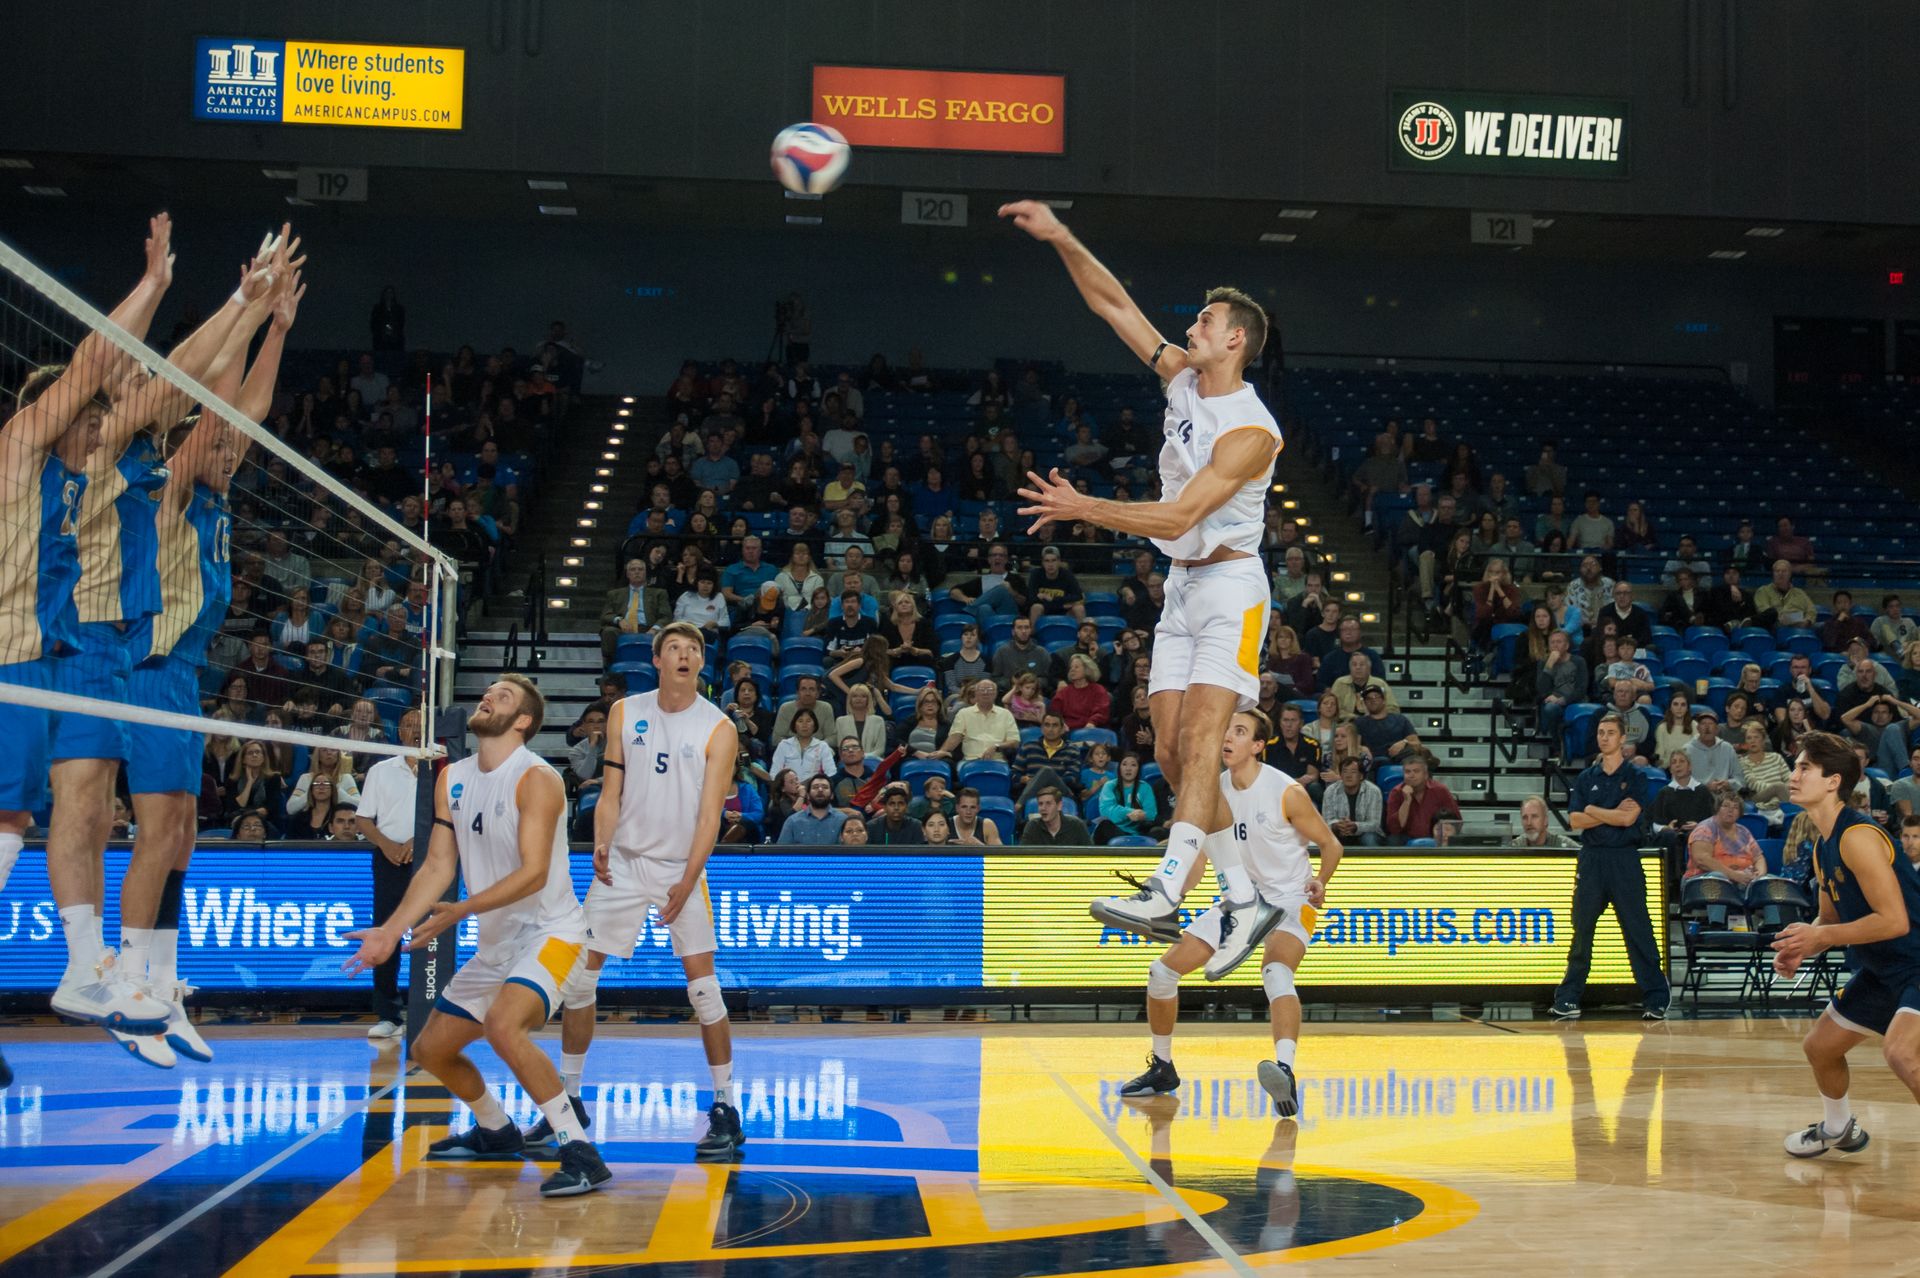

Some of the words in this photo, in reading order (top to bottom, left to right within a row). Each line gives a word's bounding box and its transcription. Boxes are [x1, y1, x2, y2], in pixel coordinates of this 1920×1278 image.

[297, 48, 357, 71] Where
[364, 53, 445, 74] students
[207, 86, 277, 97] AMERICAN
[296, 72, 334, 94] love
[341, 75, 396, 101] living.
[206, 107, 276, 116] COMMUNITIES
[207, 96, 277, 107] CAMPUS
[822, 95, 937, 120] WELLS
[945, 100, 1054, 124] FARGO
[294, 104, 450, 122] AMERICANCAMPUS.COM
[1464, 111, 1505, 156] WE
[1507, 113, 1622, 161] DELIVER!
[318, 173, 348, 195] 119
[915, 198, 953, 220] 120
[1487, 218, 1516, 240] 121
[655, 752, 669, 774] 5
[472, 812, 483, 835] 4
[1233, 822, 1247, 841] 16
[184, 887, 355, 947] Where
